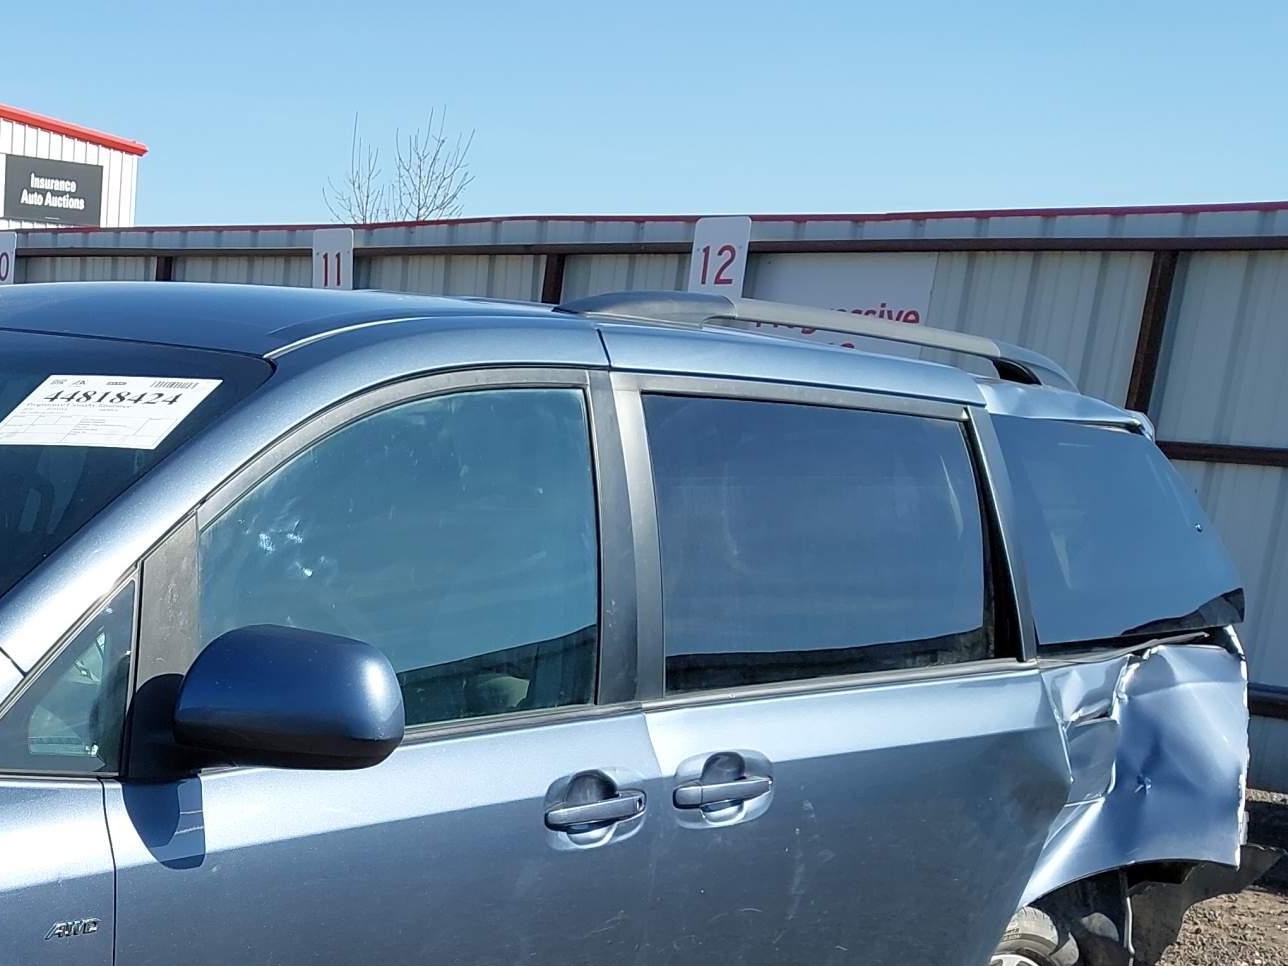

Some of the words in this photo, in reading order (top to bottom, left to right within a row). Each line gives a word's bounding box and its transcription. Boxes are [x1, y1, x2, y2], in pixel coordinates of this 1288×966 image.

[30, 172, 77, 193] Insurance
[20, 188, 43, 206] Auto
[44, 191, 86, 211] Auctions
[322, 251, 342, 288] 11
[700, 244, 737, 286] 12
[43, 390, 183, 406] 44818424
